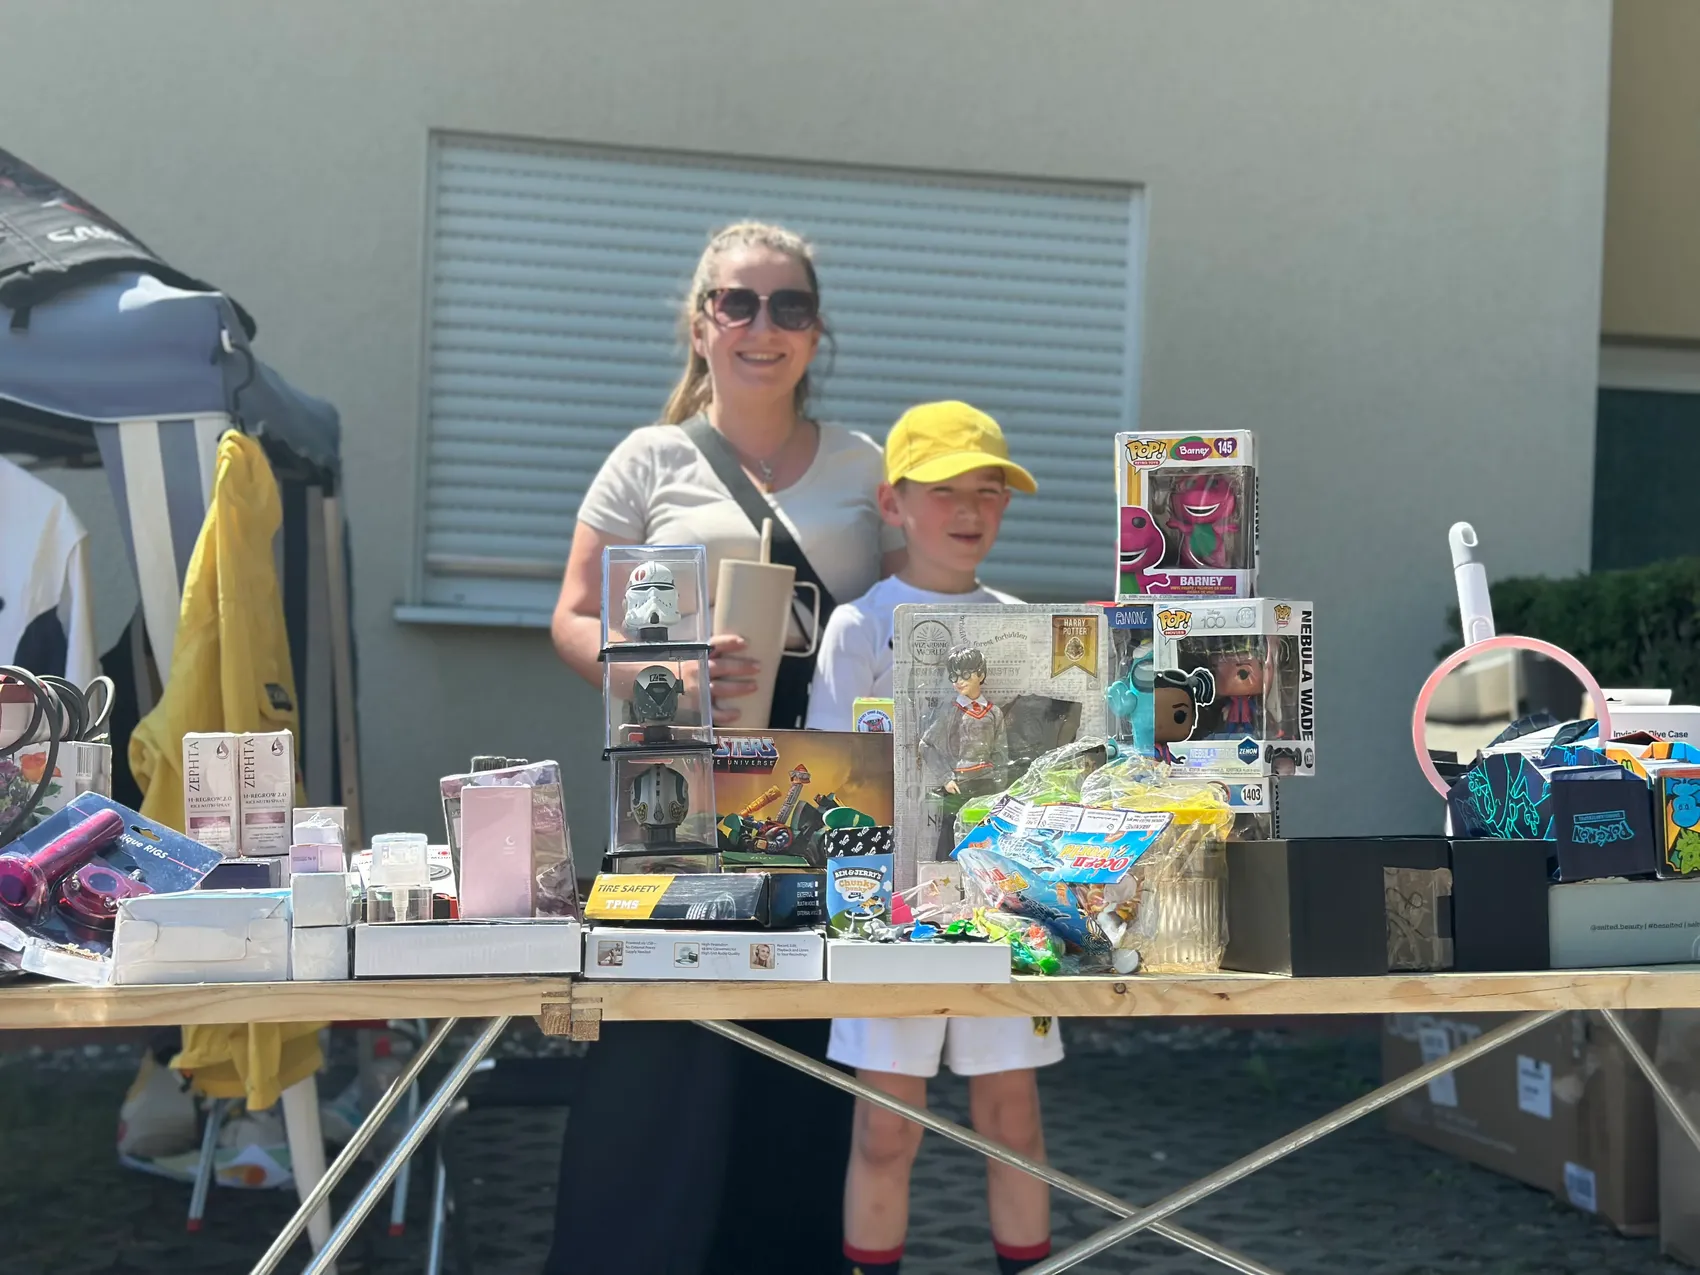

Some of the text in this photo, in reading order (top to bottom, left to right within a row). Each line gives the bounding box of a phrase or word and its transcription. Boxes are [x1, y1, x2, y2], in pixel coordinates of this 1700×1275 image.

[1125, 439, 1167, 461] POP!
[1179, 446, 1210, 456] Barney
[1217, 441, 1233, 454] 145
[1180, 576, 1223, 586] BARNEY
[1063, 618, 1086, 627] HARRY
[1115, 610, 1148, 625] AMONG
[1157, 609, 1192, 630] POP!
[1200, 616, 1227, 628] 100
[1062, 627, 1088, 635] POTTER
[973, 631, 1028, 648] forest forbidden
[1300, 610, 1313, 683] NEBULA
[1300, 688, 1313, 741] WADE
[1668, 730, 1689, 738] Case
[1239, 747, 1258, 755] ZENON
[189, 740, 200, 792] ZEPHTA
[244, 738, 255, 789] ZEPHTA
[1242, 788, 1261, 801] 1403
[120, 833, 169, 859] tique RIGS
[1058, 844, 1112, 859] World
[1072, 856, 1129, 872] Ocean
[834, 869, 848, 878] BEN
[854, 869, 882, 880] JERRY'S
[597, 884, 660, 893] TIRE SAFETY
[839, 879, 876, 890] Chunky
[605, 899, 640, 910] TPMS
